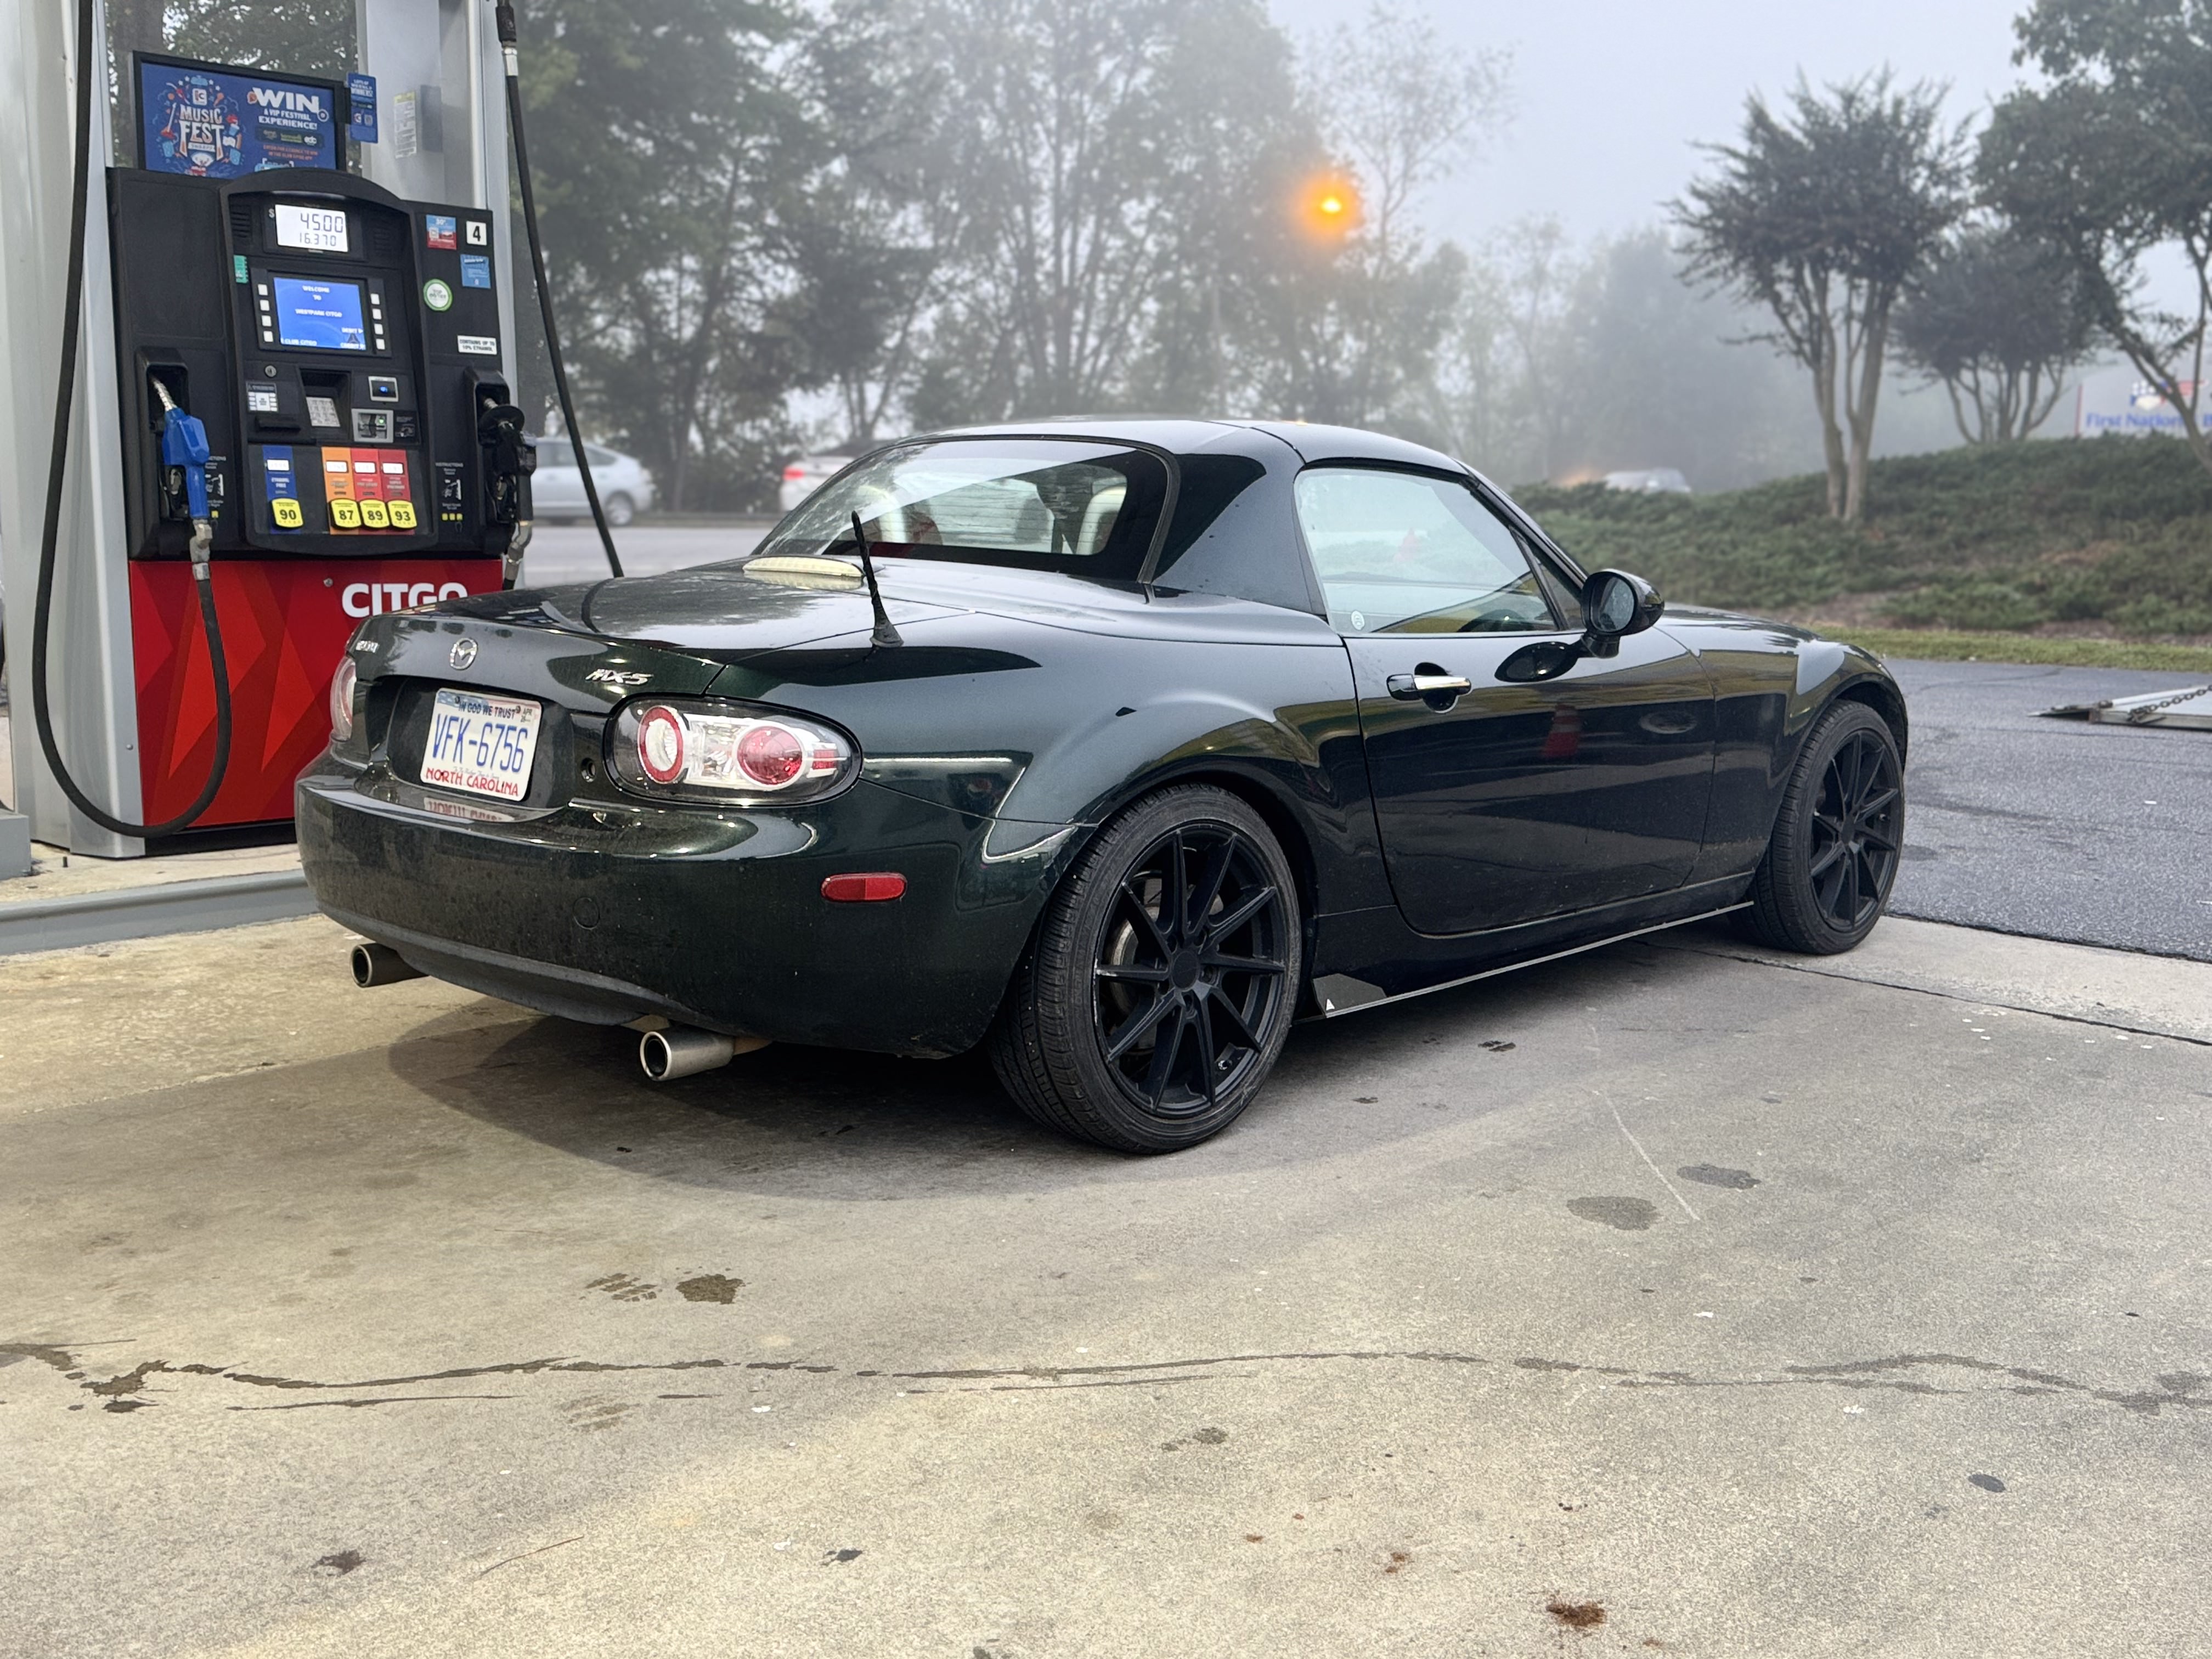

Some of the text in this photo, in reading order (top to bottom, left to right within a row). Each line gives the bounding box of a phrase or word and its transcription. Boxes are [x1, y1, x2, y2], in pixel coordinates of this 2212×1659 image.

[252, 87, 319, 114] WIN
[179, 103, 222, 124] MUSIC
[281, 110, 311, 121] FESTIVAL
[258, 116, 317, 129] EXPERIENCE!
[179, 120, 224, 160] FEST
[472, 225, 481, 242] 4
[2086, 413, 2122, 427] First
[280, 509, 296, 520] 90
[338, 510, 353, 520] 87
[368, 510, 383, 520] 89
[395, 511, 411, 521] 93
[342, 583, 468, 618] CITGO
[585, 669, 654, 685] MX-5
[459, 702, 516, 719] IN GOD WE TRUST
[432, 713, 528, 773] VFK-6756
[426, 767, 463, 786] NORTH
[466, 774, 519, 796] CAROLINA
